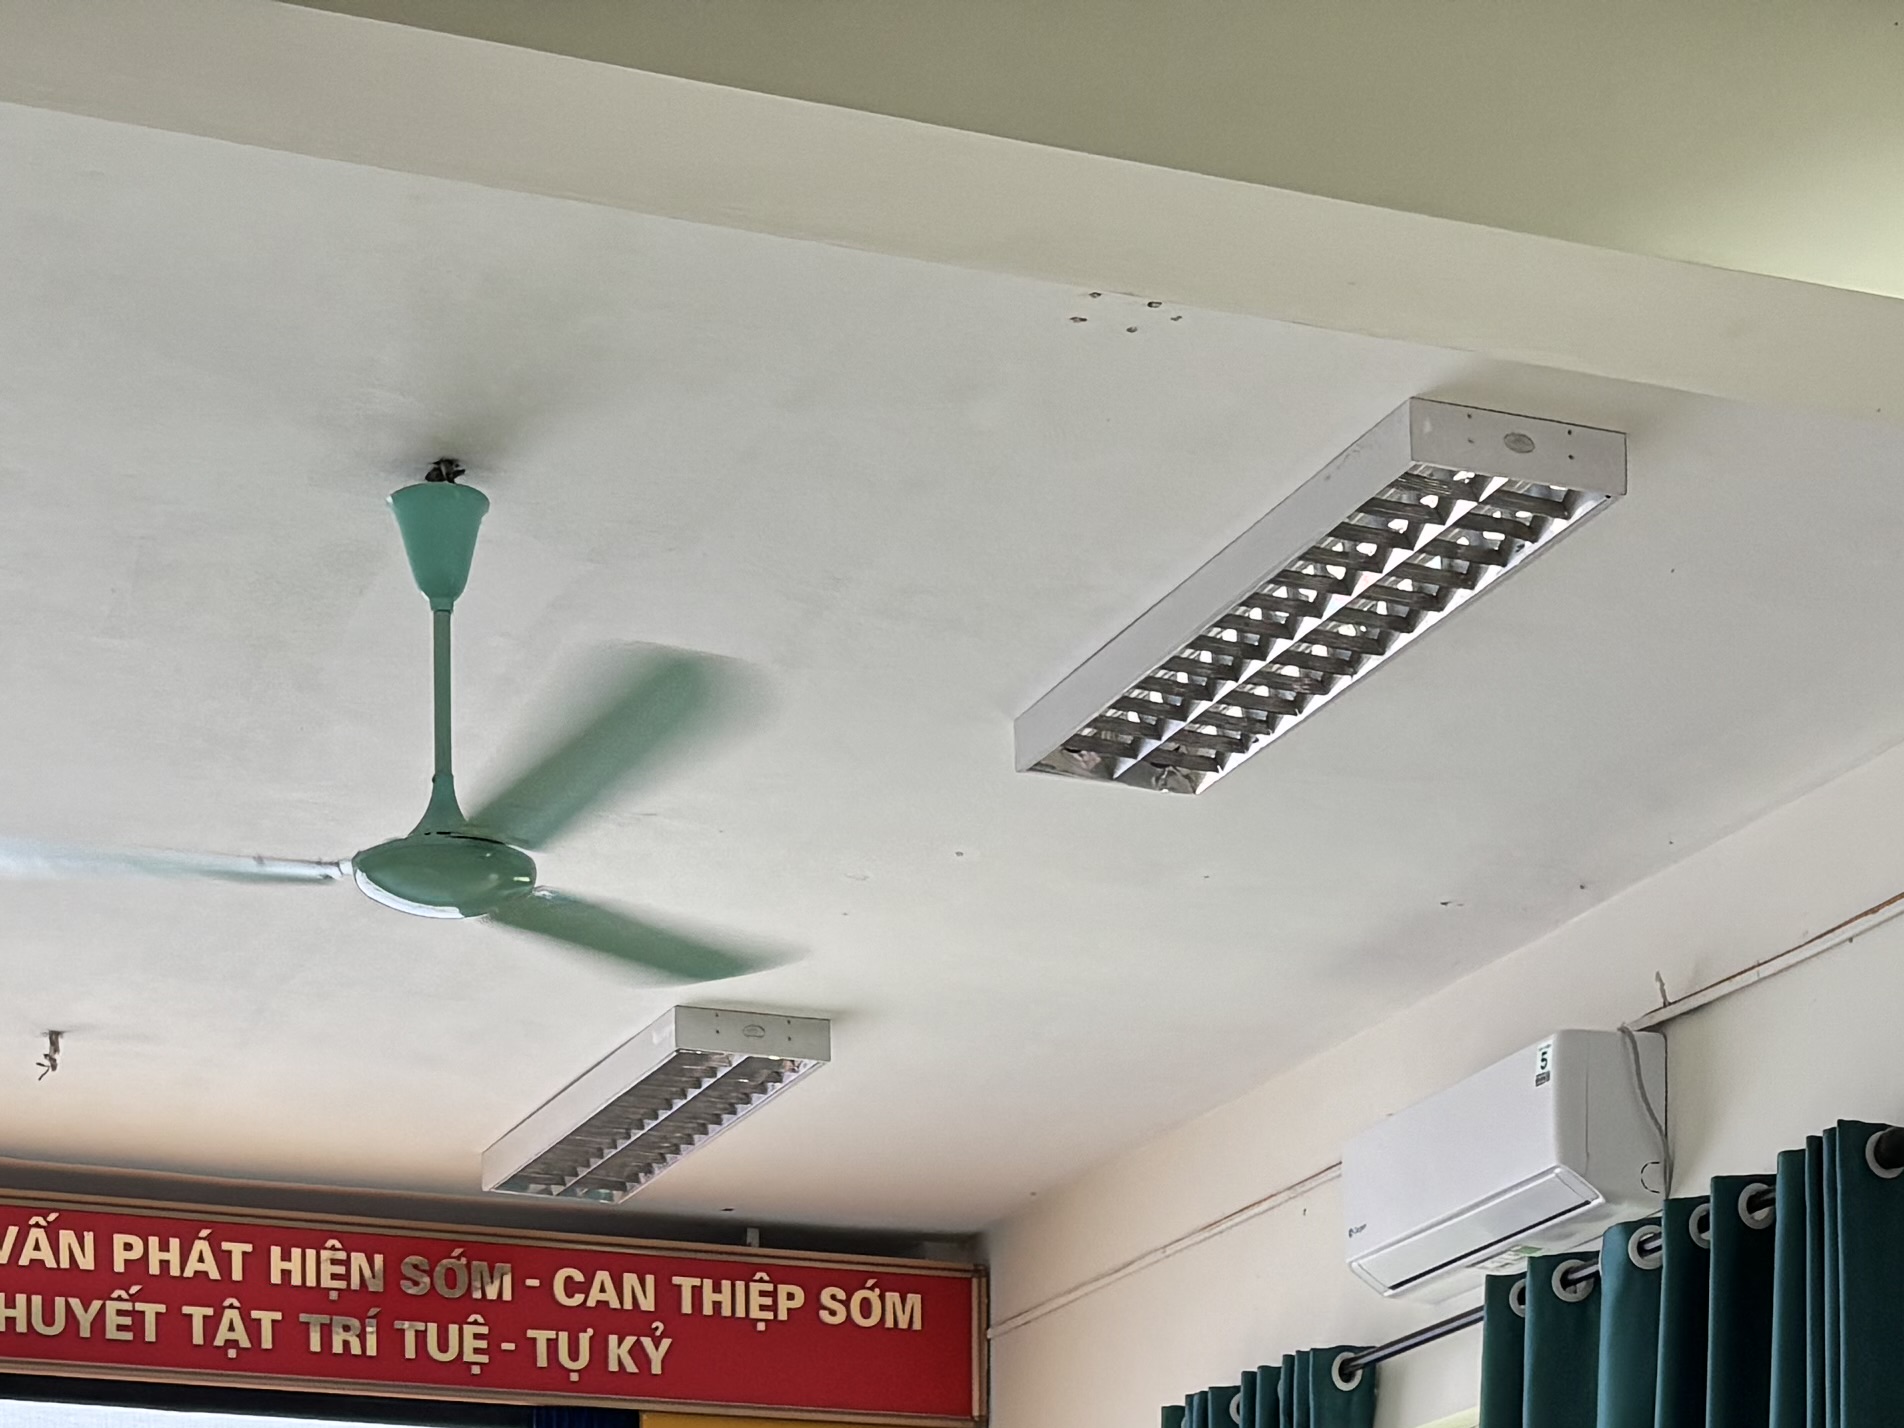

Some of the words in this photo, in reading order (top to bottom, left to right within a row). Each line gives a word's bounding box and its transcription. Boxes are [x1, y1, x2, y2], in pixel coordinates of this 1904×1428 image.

[112, 1227, 246, 1282] PHÁT
[270, 1238, 384, 1300] HIỆN
[400, 1248, 512, 1302] SỚM
[552, 1267, 656, 1312] CAN
[671, 1271, 805, 1331] THIỆP
[818, 1278, 922, 1331] SỚM
[181, 1297, 283, 1359] TẬT
[299, 1307, 381, 1357] TRÍ
[394, 1313, 490, 1375] TUỆ
[526, 1325, 594, 1382] TỰ
[607, 1320, 673, 1375] KỶ
